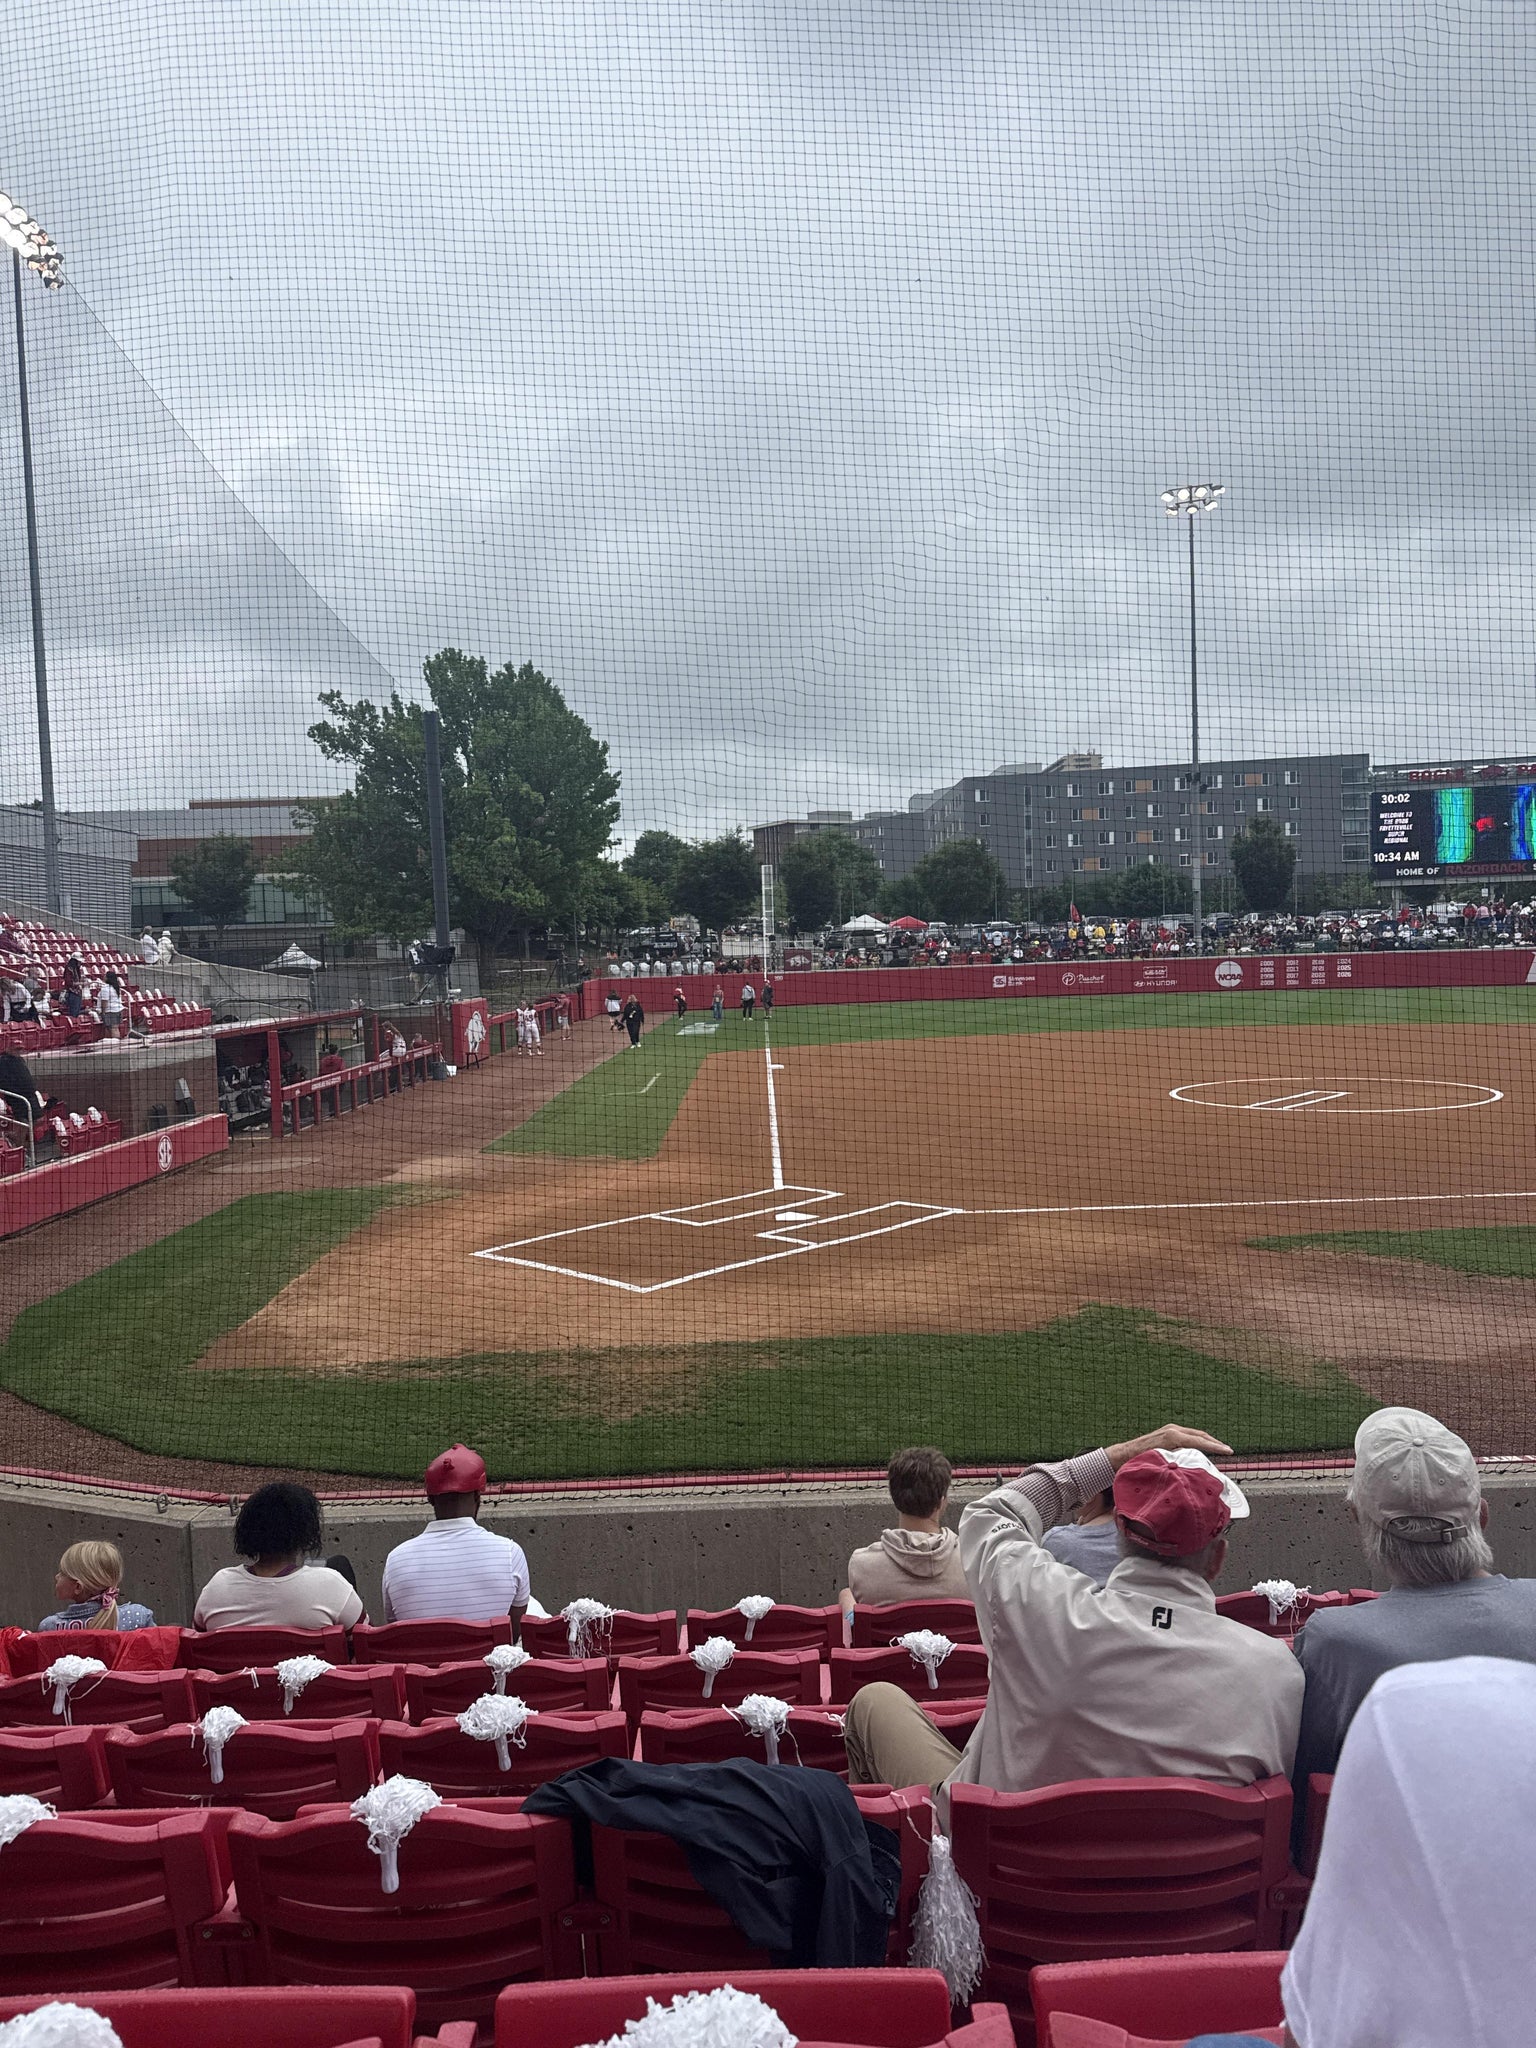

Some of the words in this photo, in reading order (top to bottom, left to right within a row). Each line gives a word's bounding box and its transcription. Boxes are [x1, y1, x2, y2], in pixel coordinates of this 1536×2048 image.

[1381, 793, 1410, 804] 30:02
[1374, 852, 1401, 862] 10:34
[1404, 851, 1420, 861] AM
[1396, 868, 1424, 876] HOME
[1426, 867, 1440, 875] OF
[1445, 863, 1527, 875] RAZORBACK
[1218, 973, 1243, 981] NCAA
[1152, 1606, 1173, 1629] FJ
